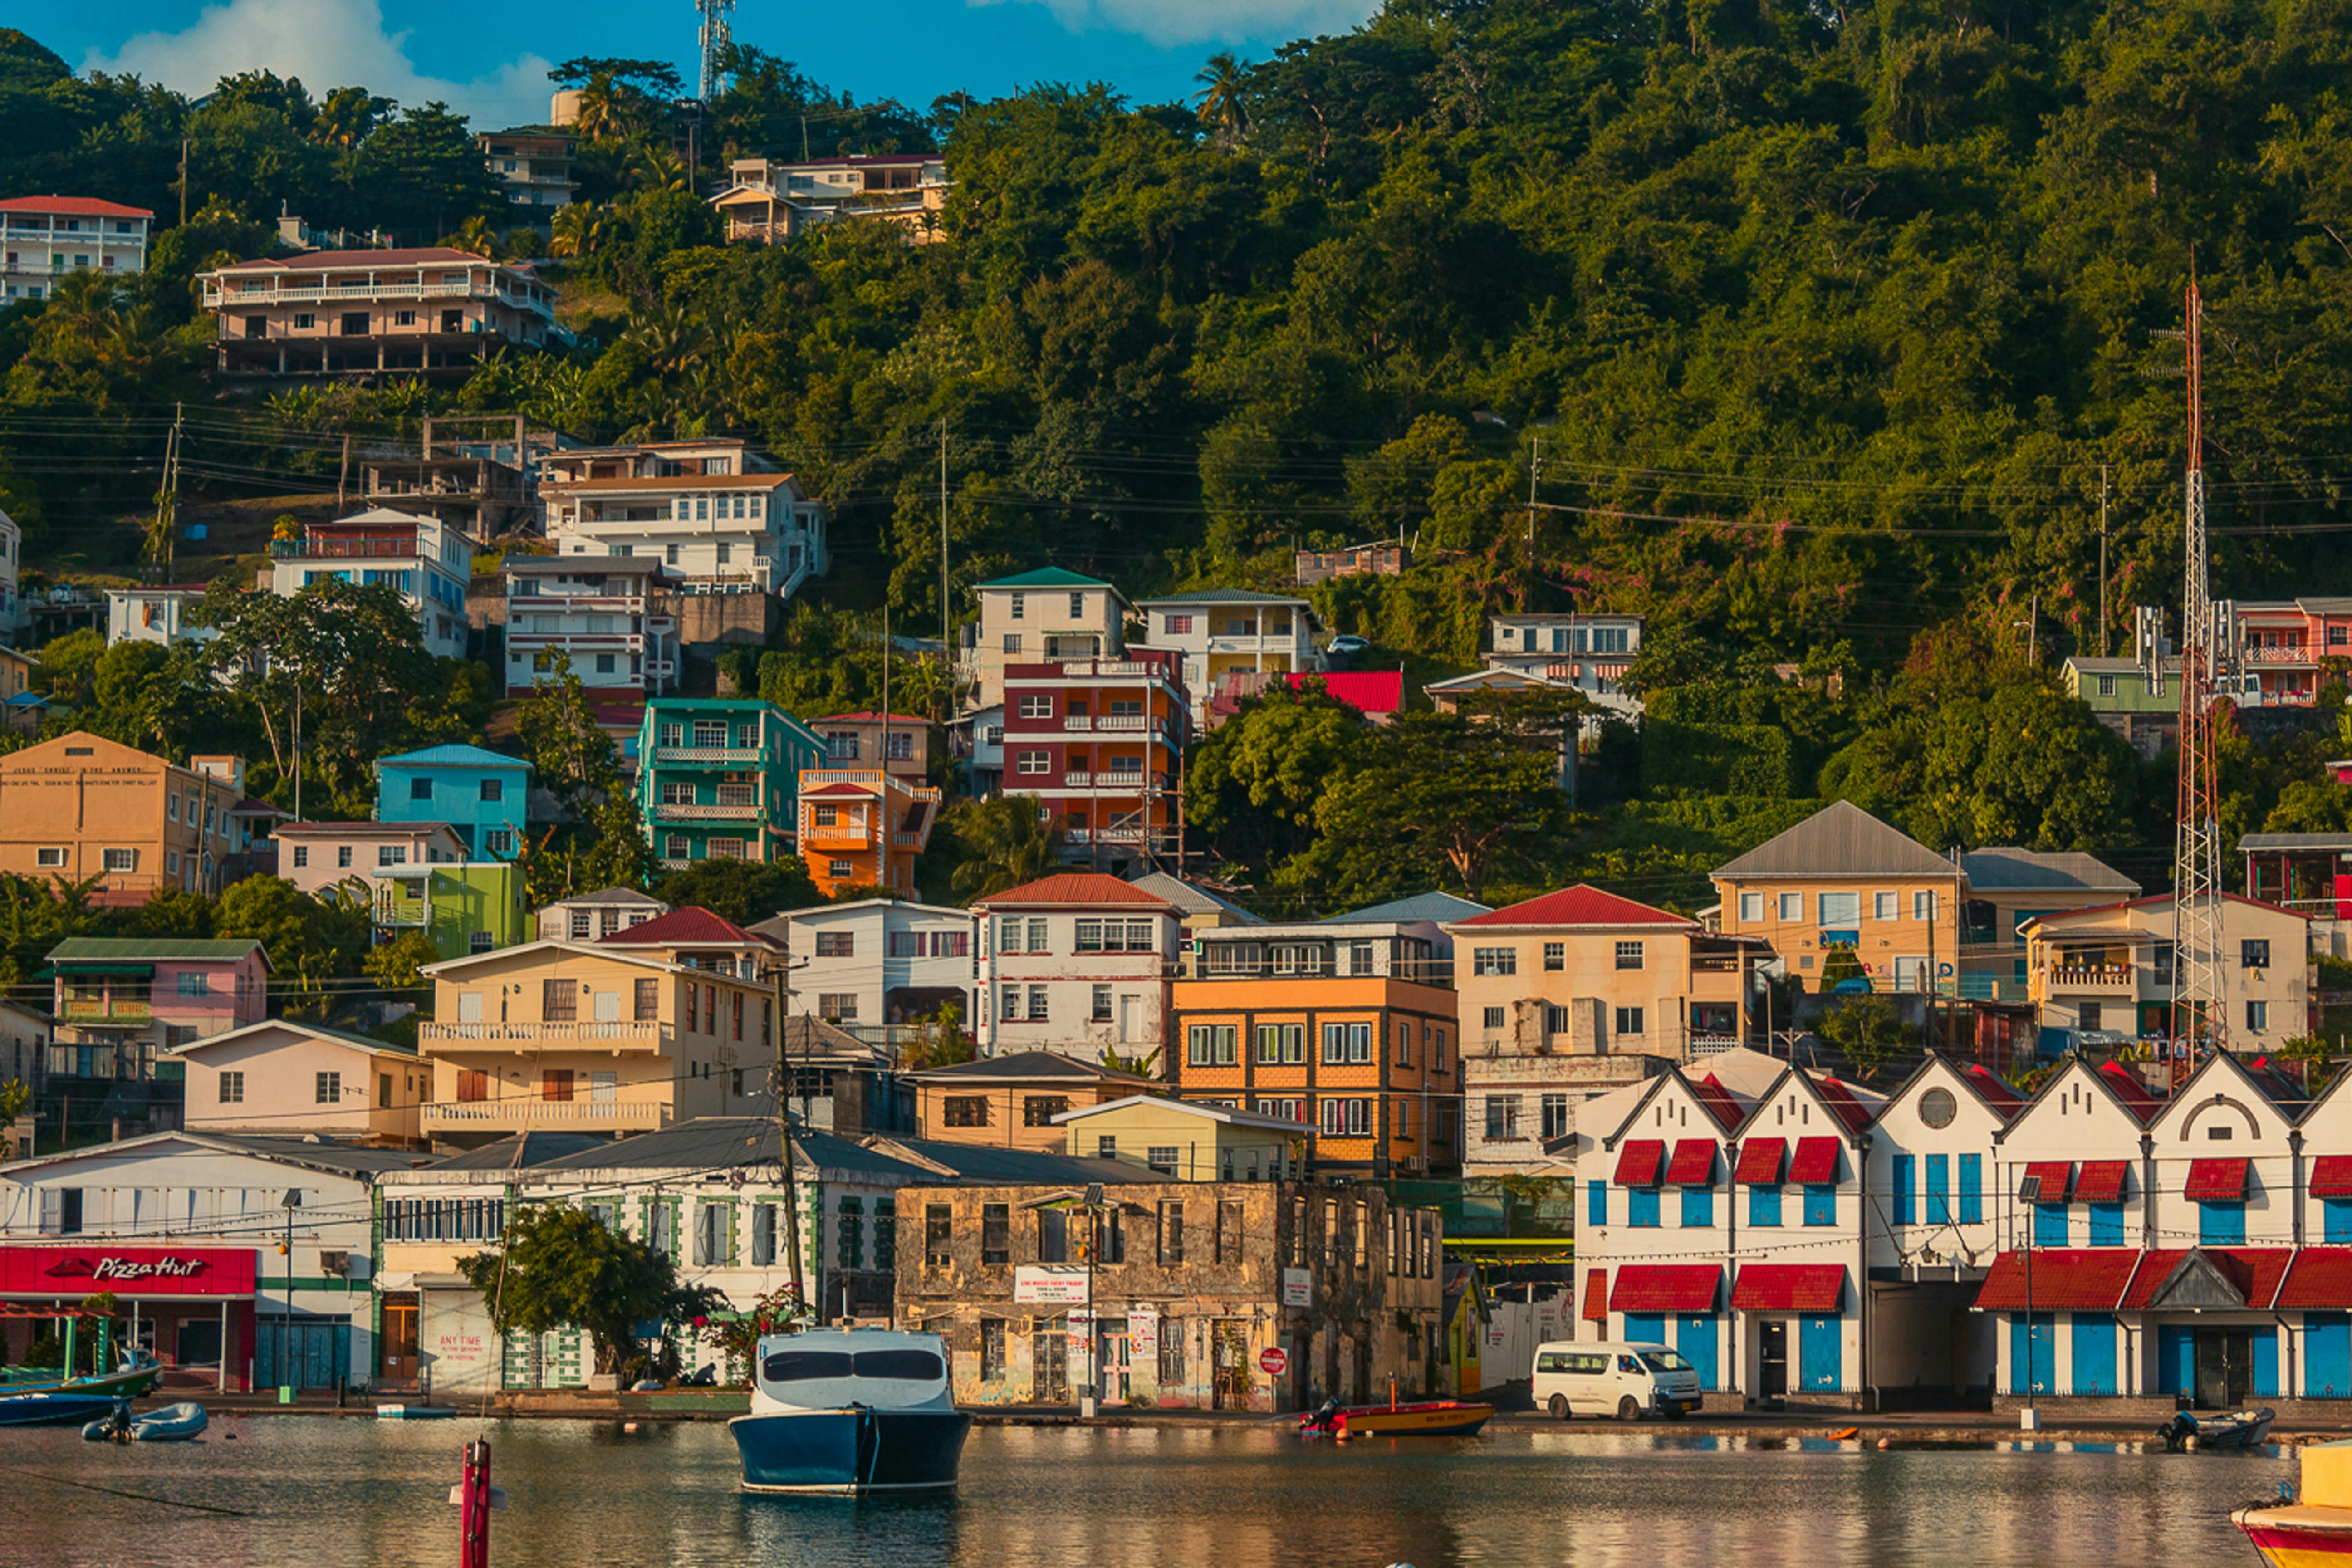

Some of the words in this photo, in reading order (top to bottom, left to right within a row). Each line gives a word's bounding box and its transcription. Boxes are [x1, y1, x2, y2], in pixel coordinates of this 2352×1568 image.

[93, 1257, 152, 1280] Pizza
[155, 1256, 203, 1276] Hut
[440, 1336, 456, 1345] ANY
[460, 1336, 480, 1345] TIME
